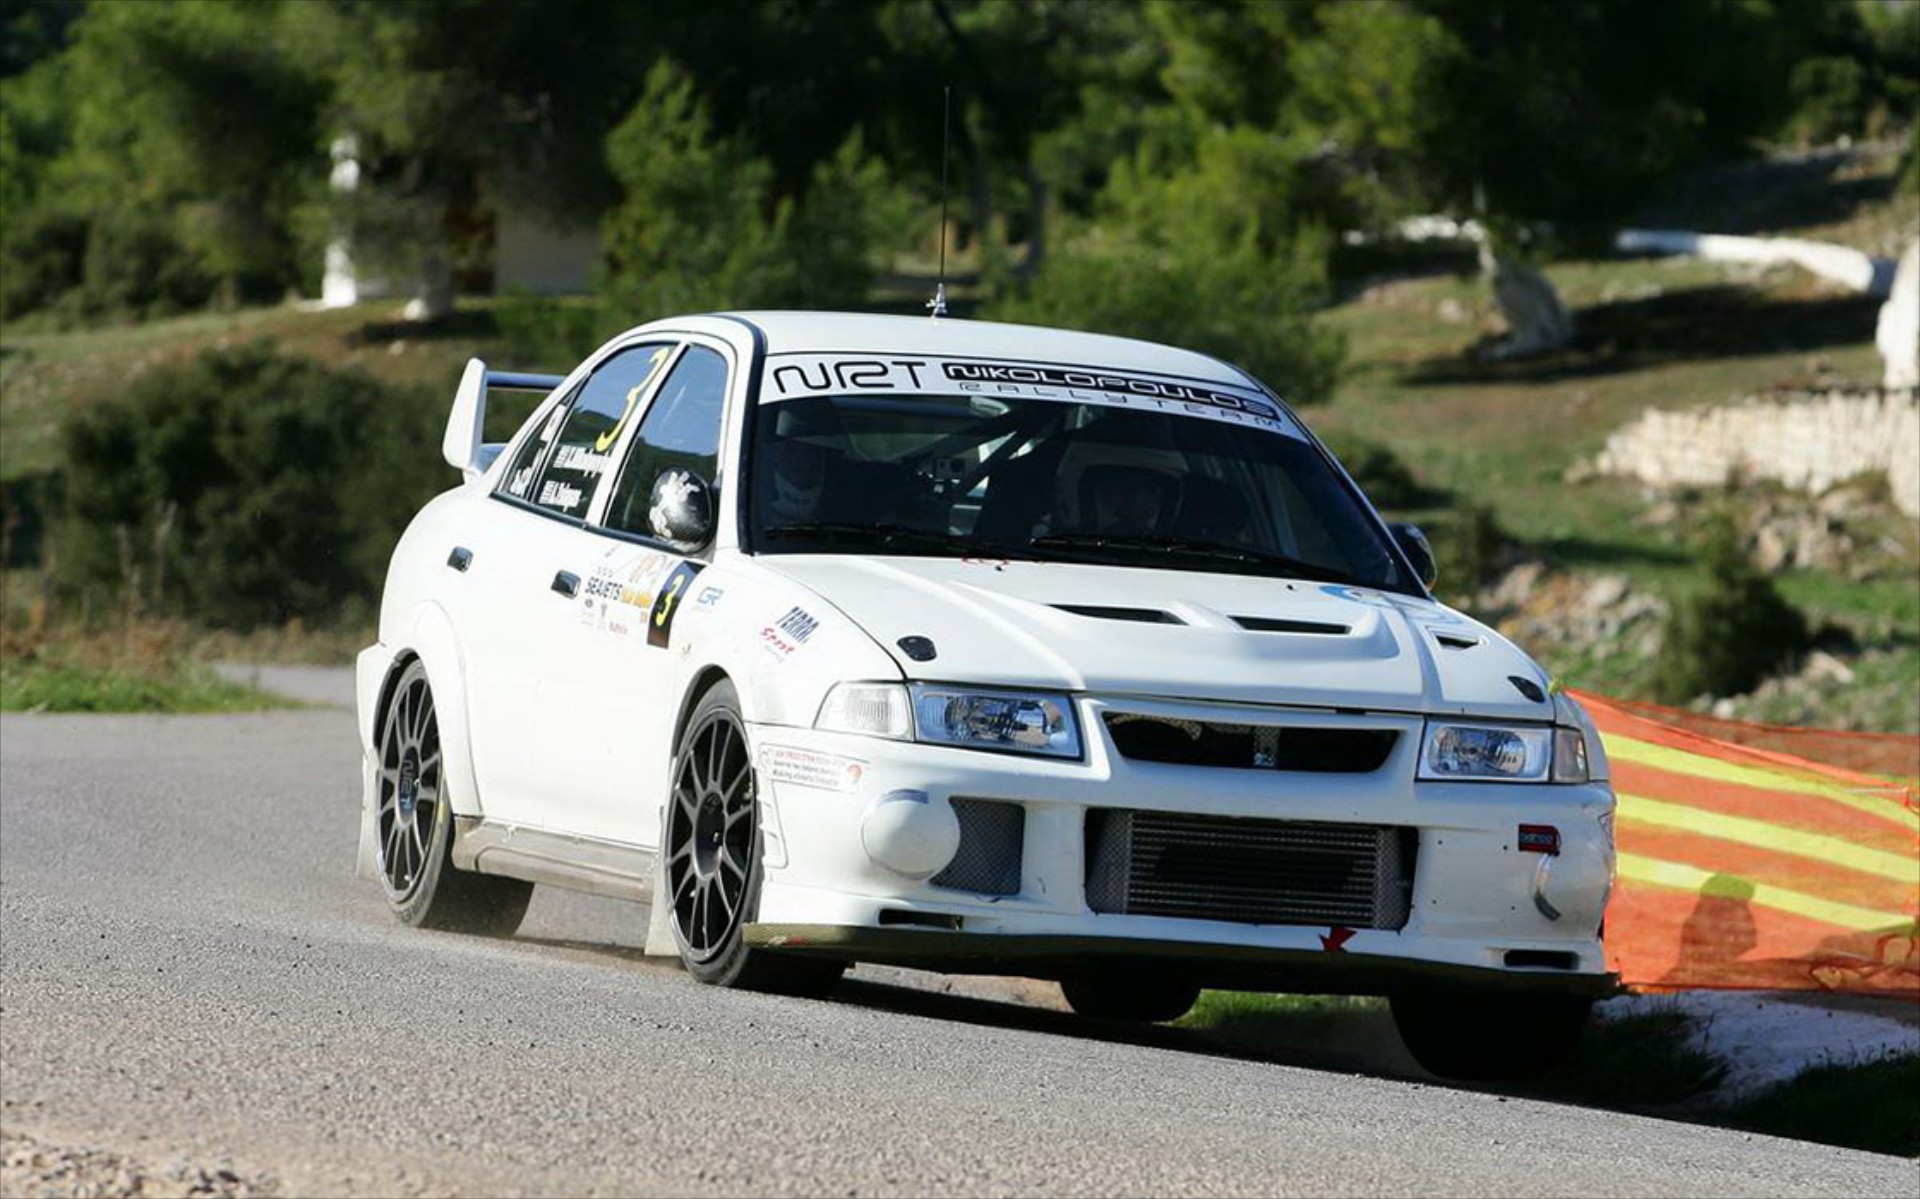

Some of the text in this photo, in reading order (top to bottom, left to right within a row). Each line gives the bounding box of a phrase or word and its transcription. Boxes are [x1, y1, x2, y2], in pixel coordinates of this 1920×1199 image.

[594, 347, 670, 452] 3
[773, 361, 1277, 419] NRT NIKOLOPOULOS
[959, 382, 1282, 430] RALLY TEAM
[584, 577, 623, 600] SEAJETS
[655, 573, 686, 627] 3
